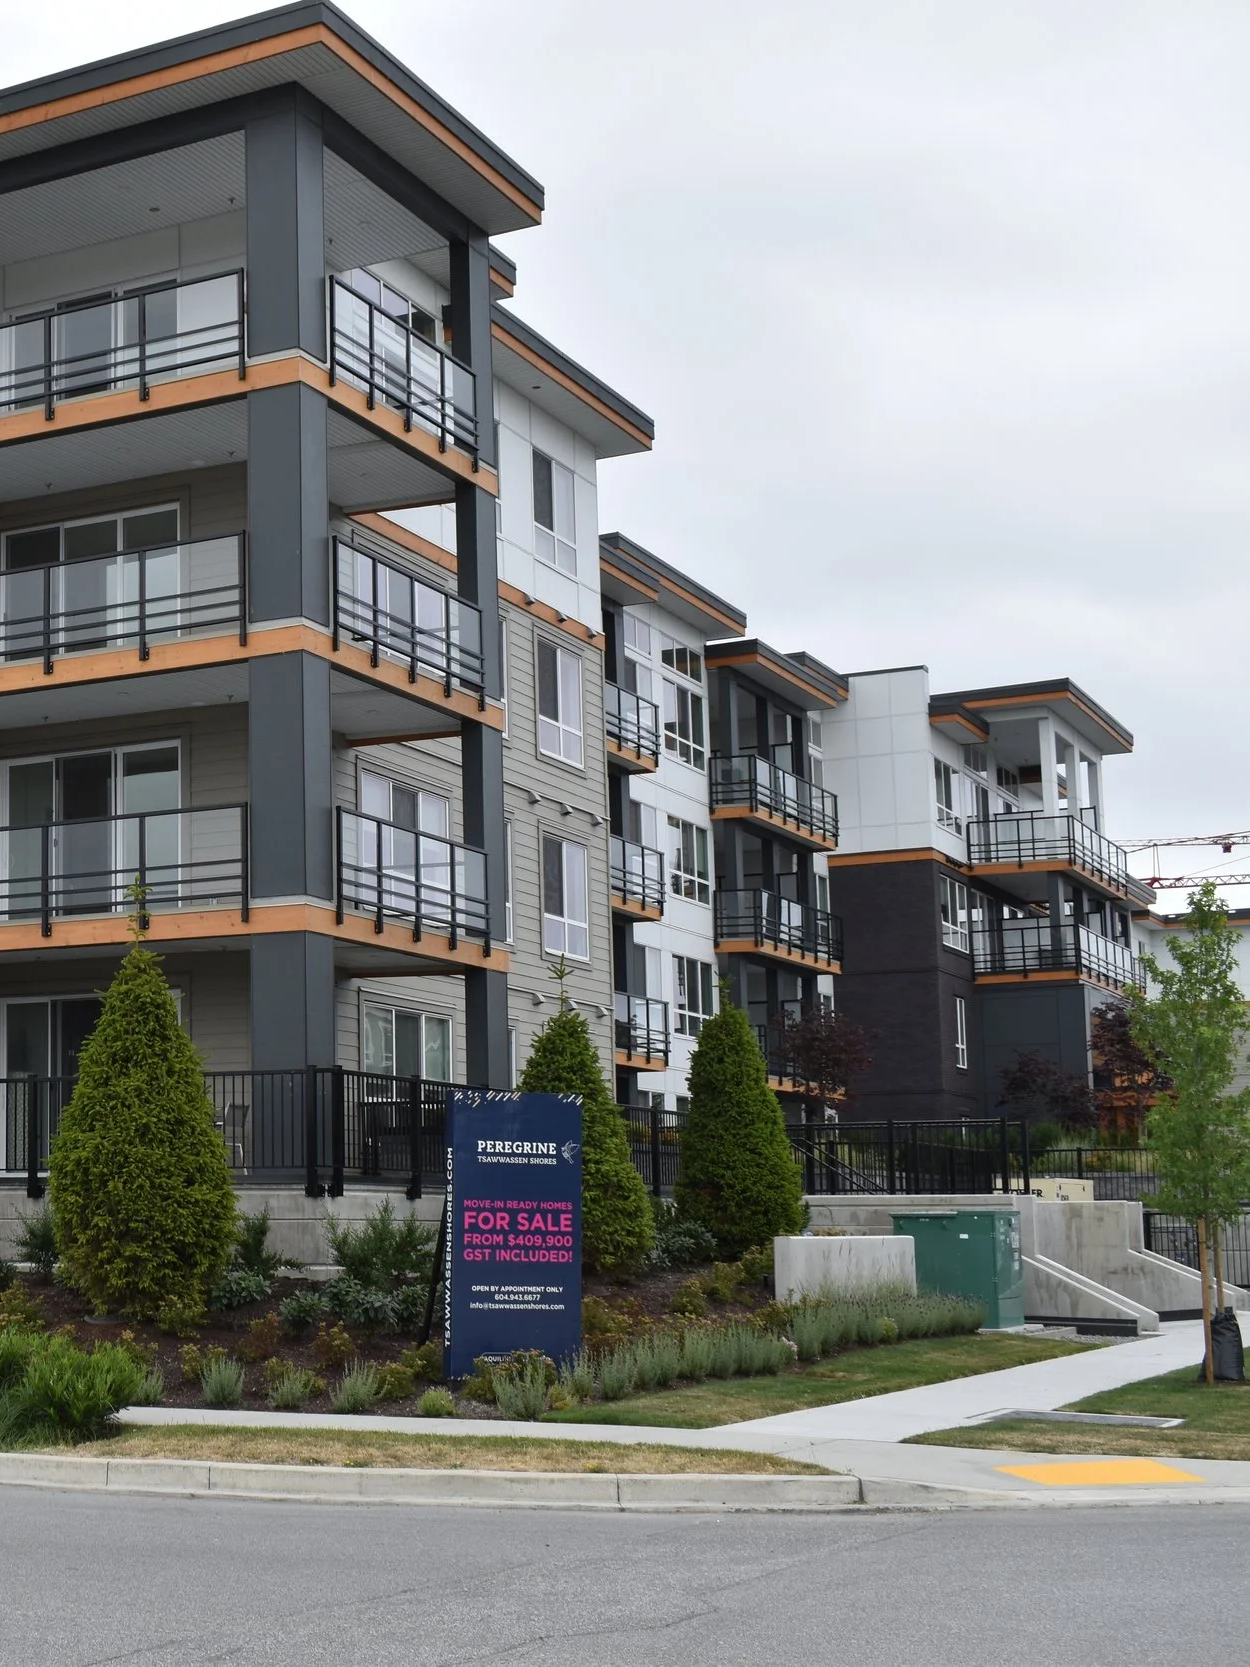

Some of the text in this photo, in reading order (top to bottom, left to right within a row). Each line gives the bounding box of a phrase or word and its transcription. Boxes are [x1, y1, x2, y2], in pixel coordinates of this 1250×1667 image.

[477, 1140, 557, 1155] PEREGRINE
[477, 1155, 557, 1165] TSAWWASSEN SHORES
[463, 1199, 573, 1210] MOVE-IN READY HOMES
[463, 1211, 573, 1232] FOR SALE
[444, 1147, 453, 1348] TSAWWASSENSHORES.COM
[463, 1233, 573, 1248] FROM $409,900
[463, 1248, 573, 1263] GST INCLUDED!
[494, 1293, 541, 1301] 604.943.6677
[469, 1301, 565, 1310] info@tsawwassenshores.com
